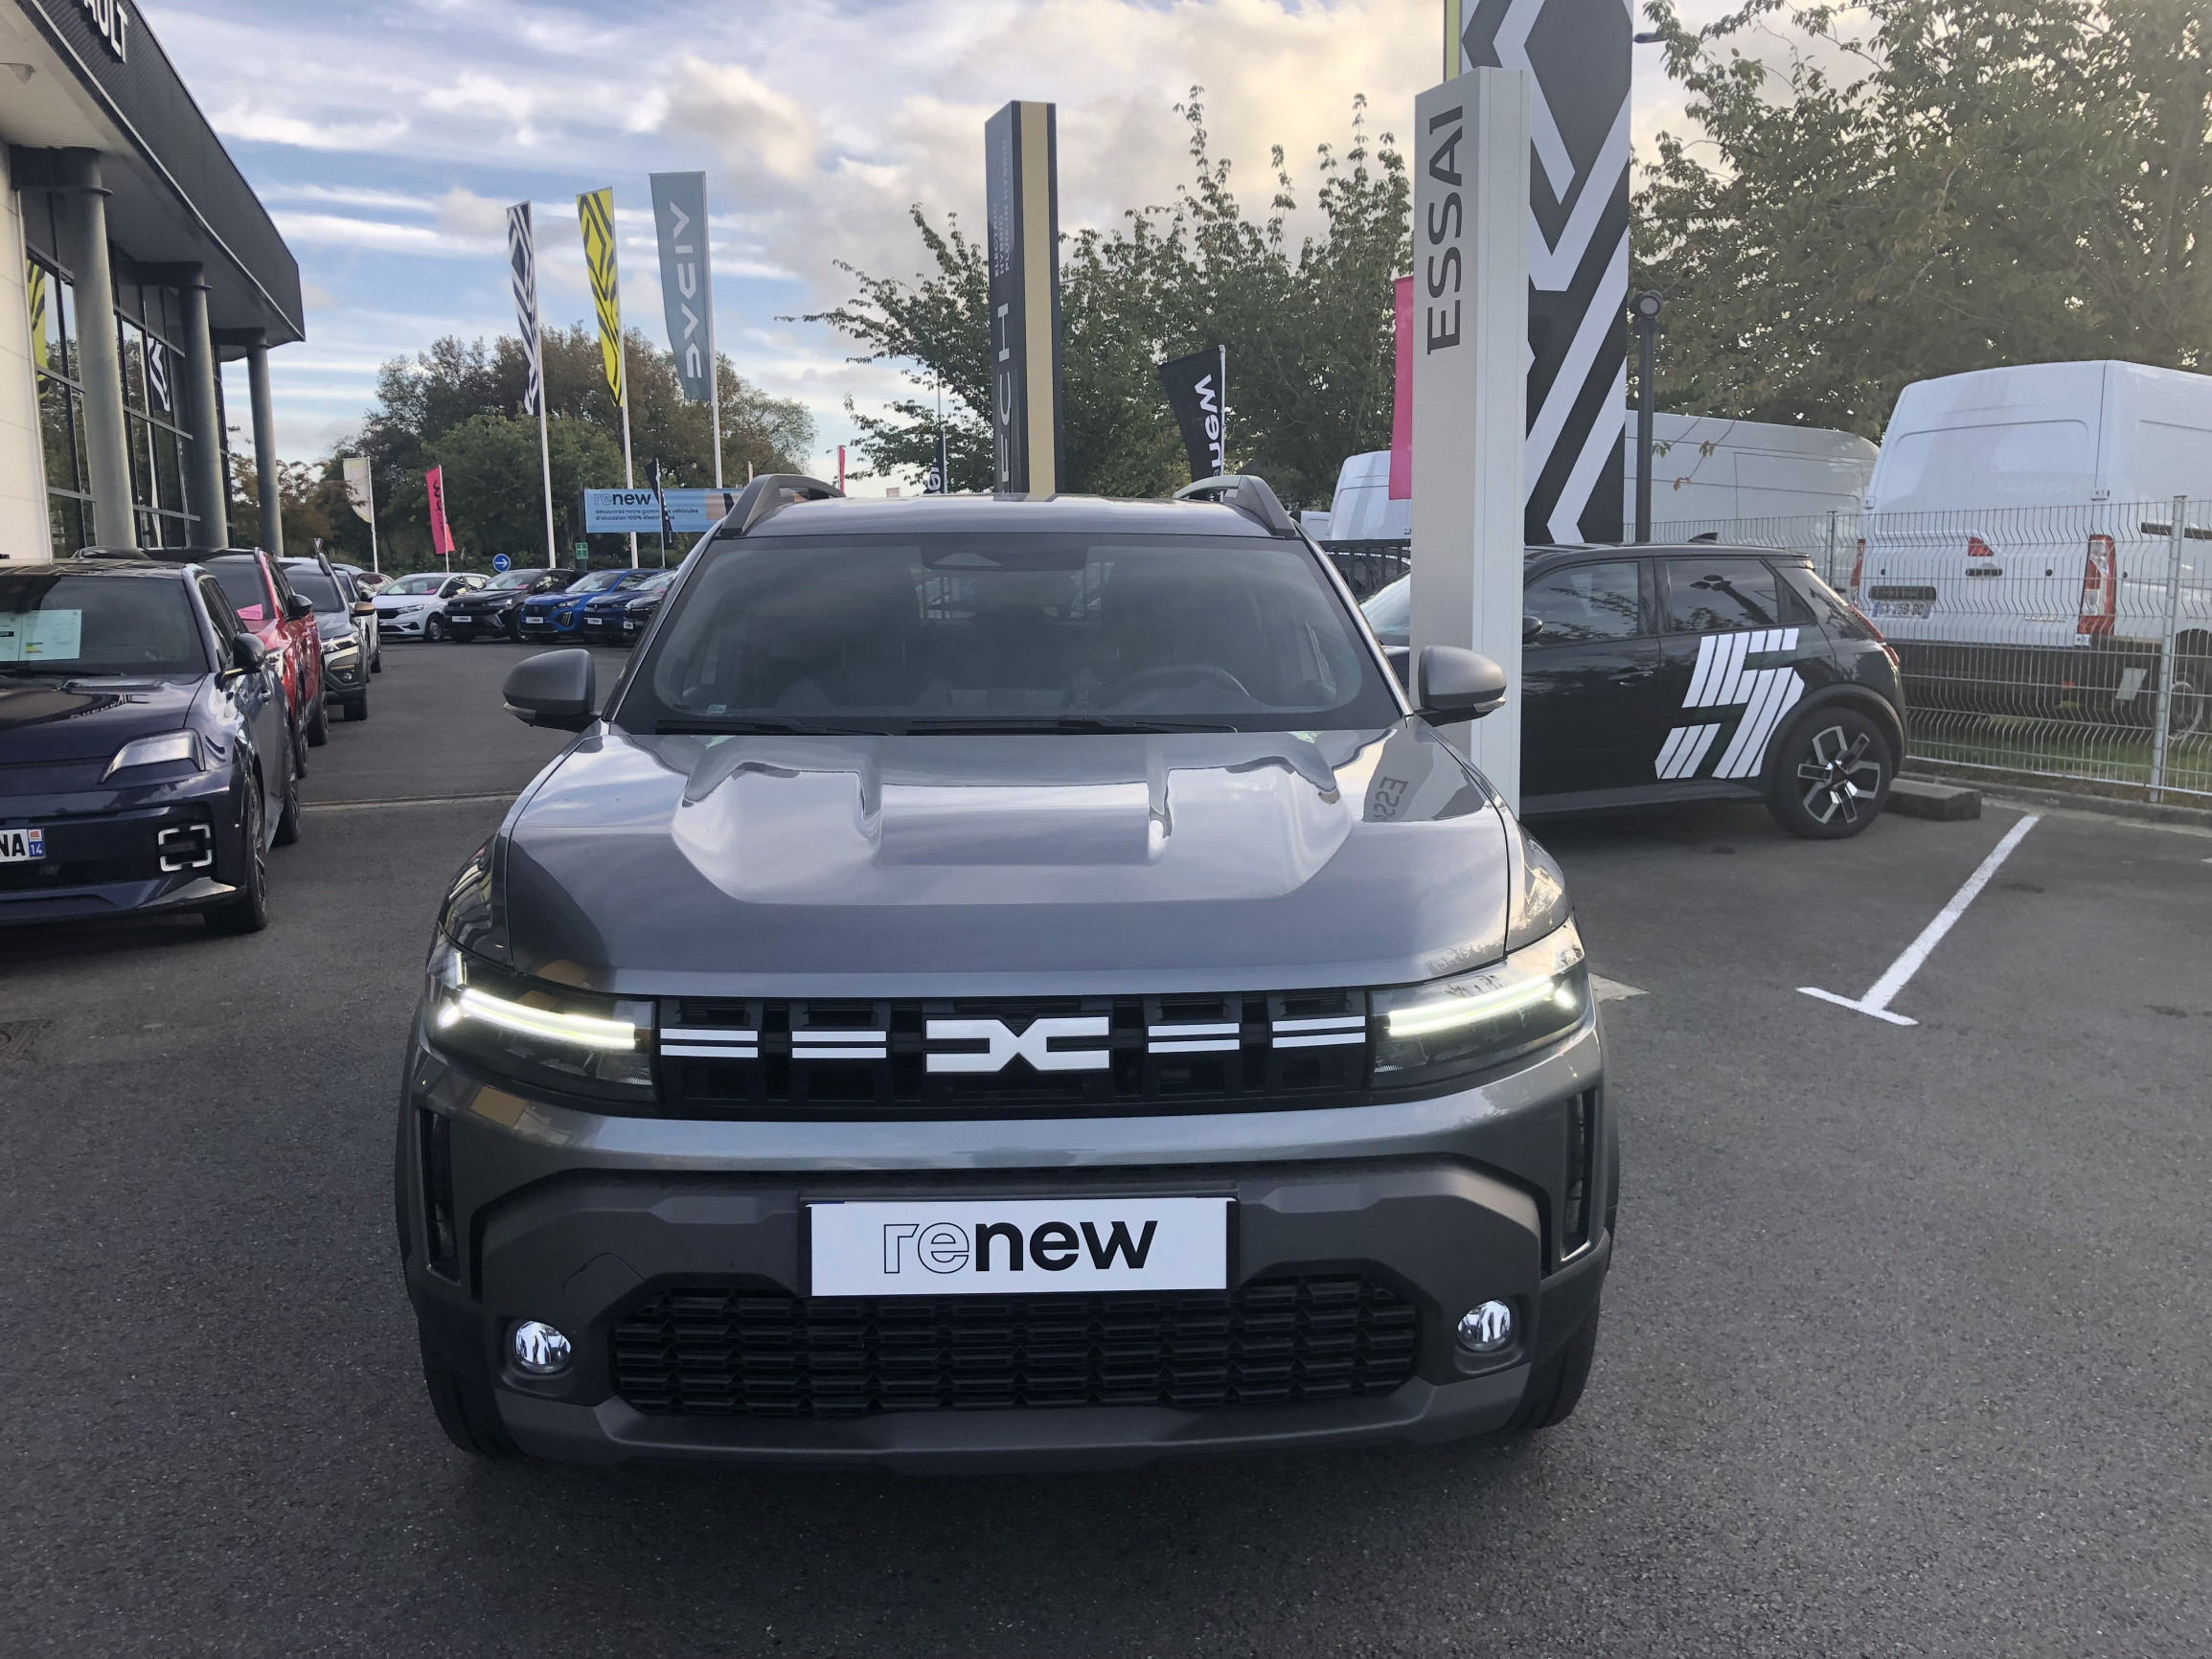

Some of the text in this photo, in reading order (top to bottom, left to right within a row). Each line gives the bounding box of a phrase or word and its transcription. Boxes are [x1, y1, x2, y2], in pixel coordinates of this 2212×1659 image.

[1426, 104, 1463, 355] ESSAI
[594, 492, 651, 506] renew
[30, 843, 43, 855] 14
[883, 1220, 1158, 1274] renew
